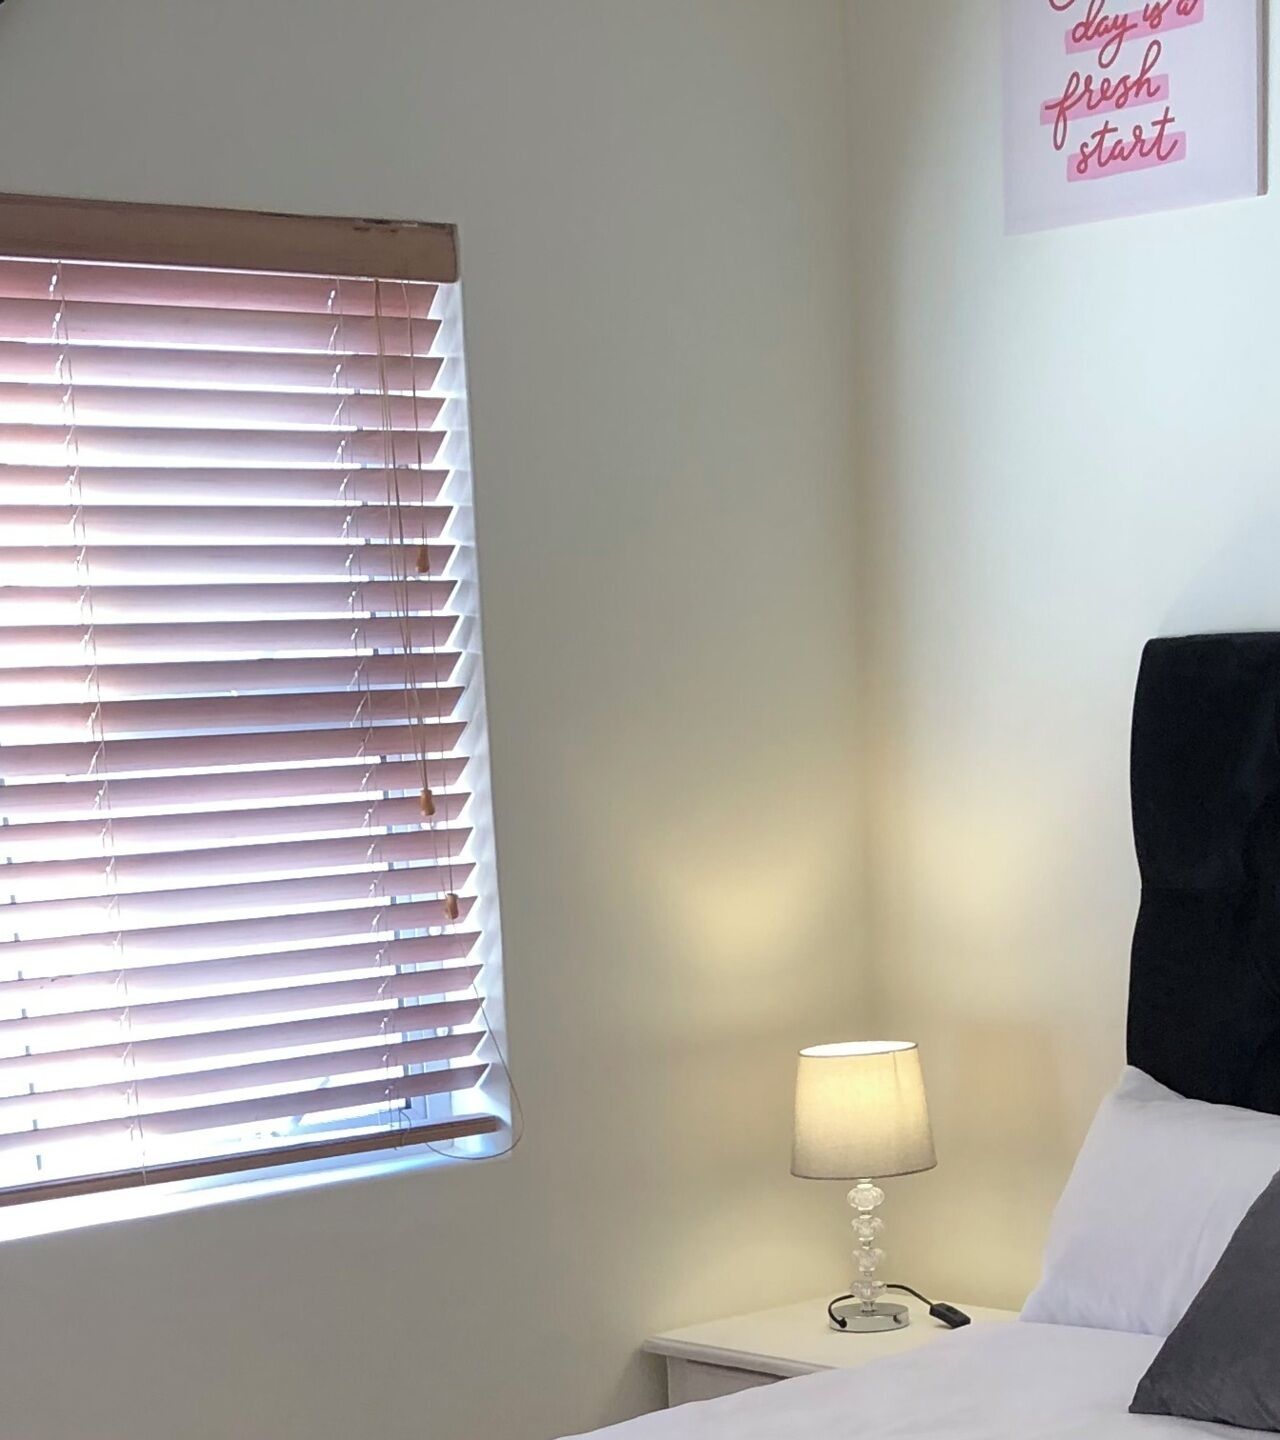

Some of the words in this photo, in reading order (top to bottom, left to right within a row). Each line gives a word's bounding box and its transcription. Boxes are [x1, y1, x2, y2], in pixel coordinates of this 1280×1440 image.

[1071, 0, 1138, 69] day
[1044, 39, 1161, 151] fresh
[1076, 106, 1178, 174] start
